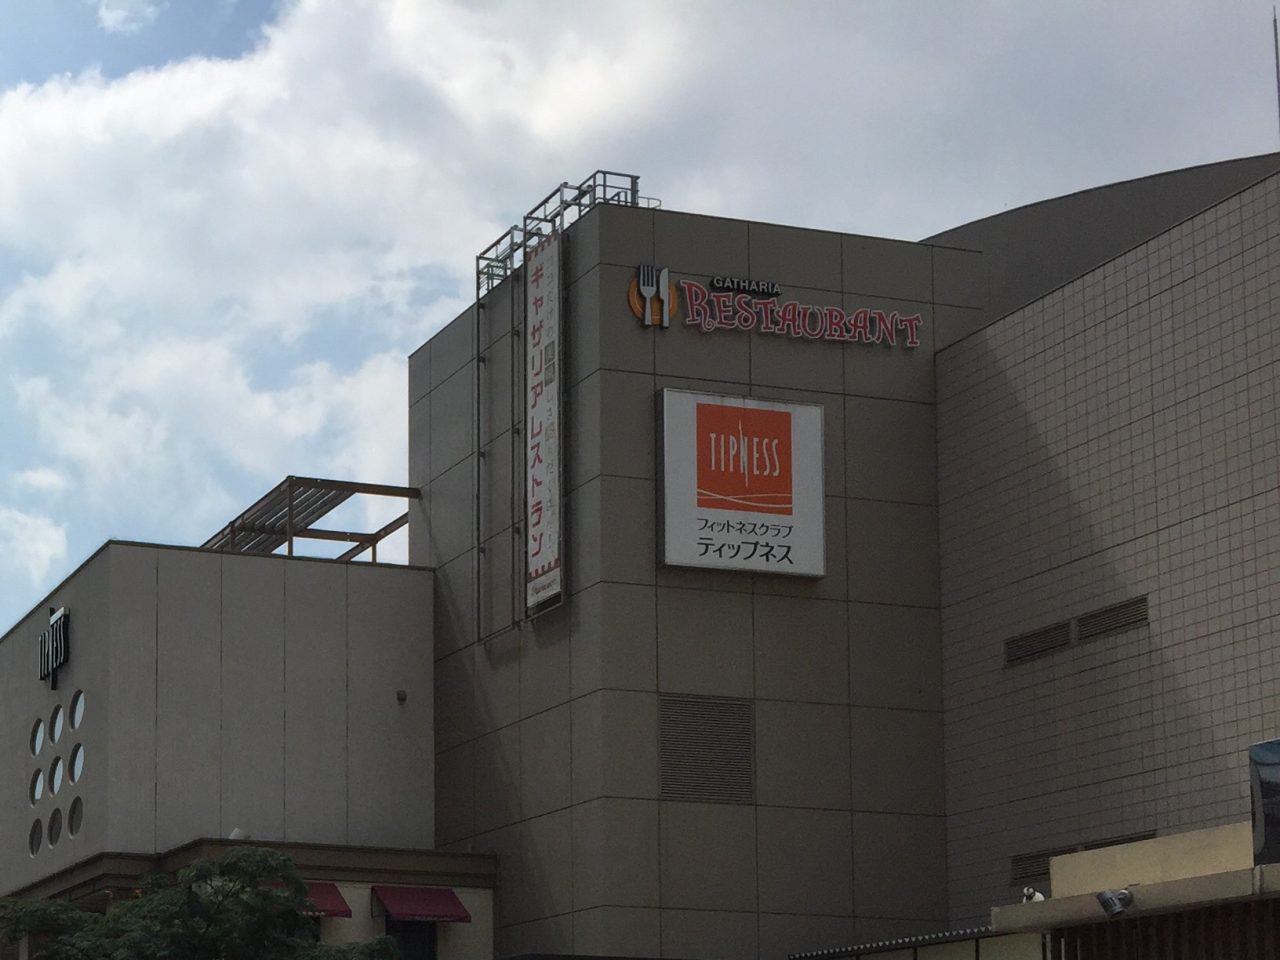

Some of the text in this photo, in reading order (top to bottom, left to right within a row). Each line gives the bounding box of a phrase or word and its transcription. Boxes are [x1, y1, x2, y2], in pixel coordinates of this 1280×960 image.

[713, 276, 782, 295] GATHARIA
[679, 279, 923, 347] RESTAURANT
[529, 264, 545, 559] ギャザリアレストラン
[709, 419, 781, 488] TIPNESS
[696, 537, 795, 565] ティップネス
[697, 517, 794, 538] フィットネスクラブ
